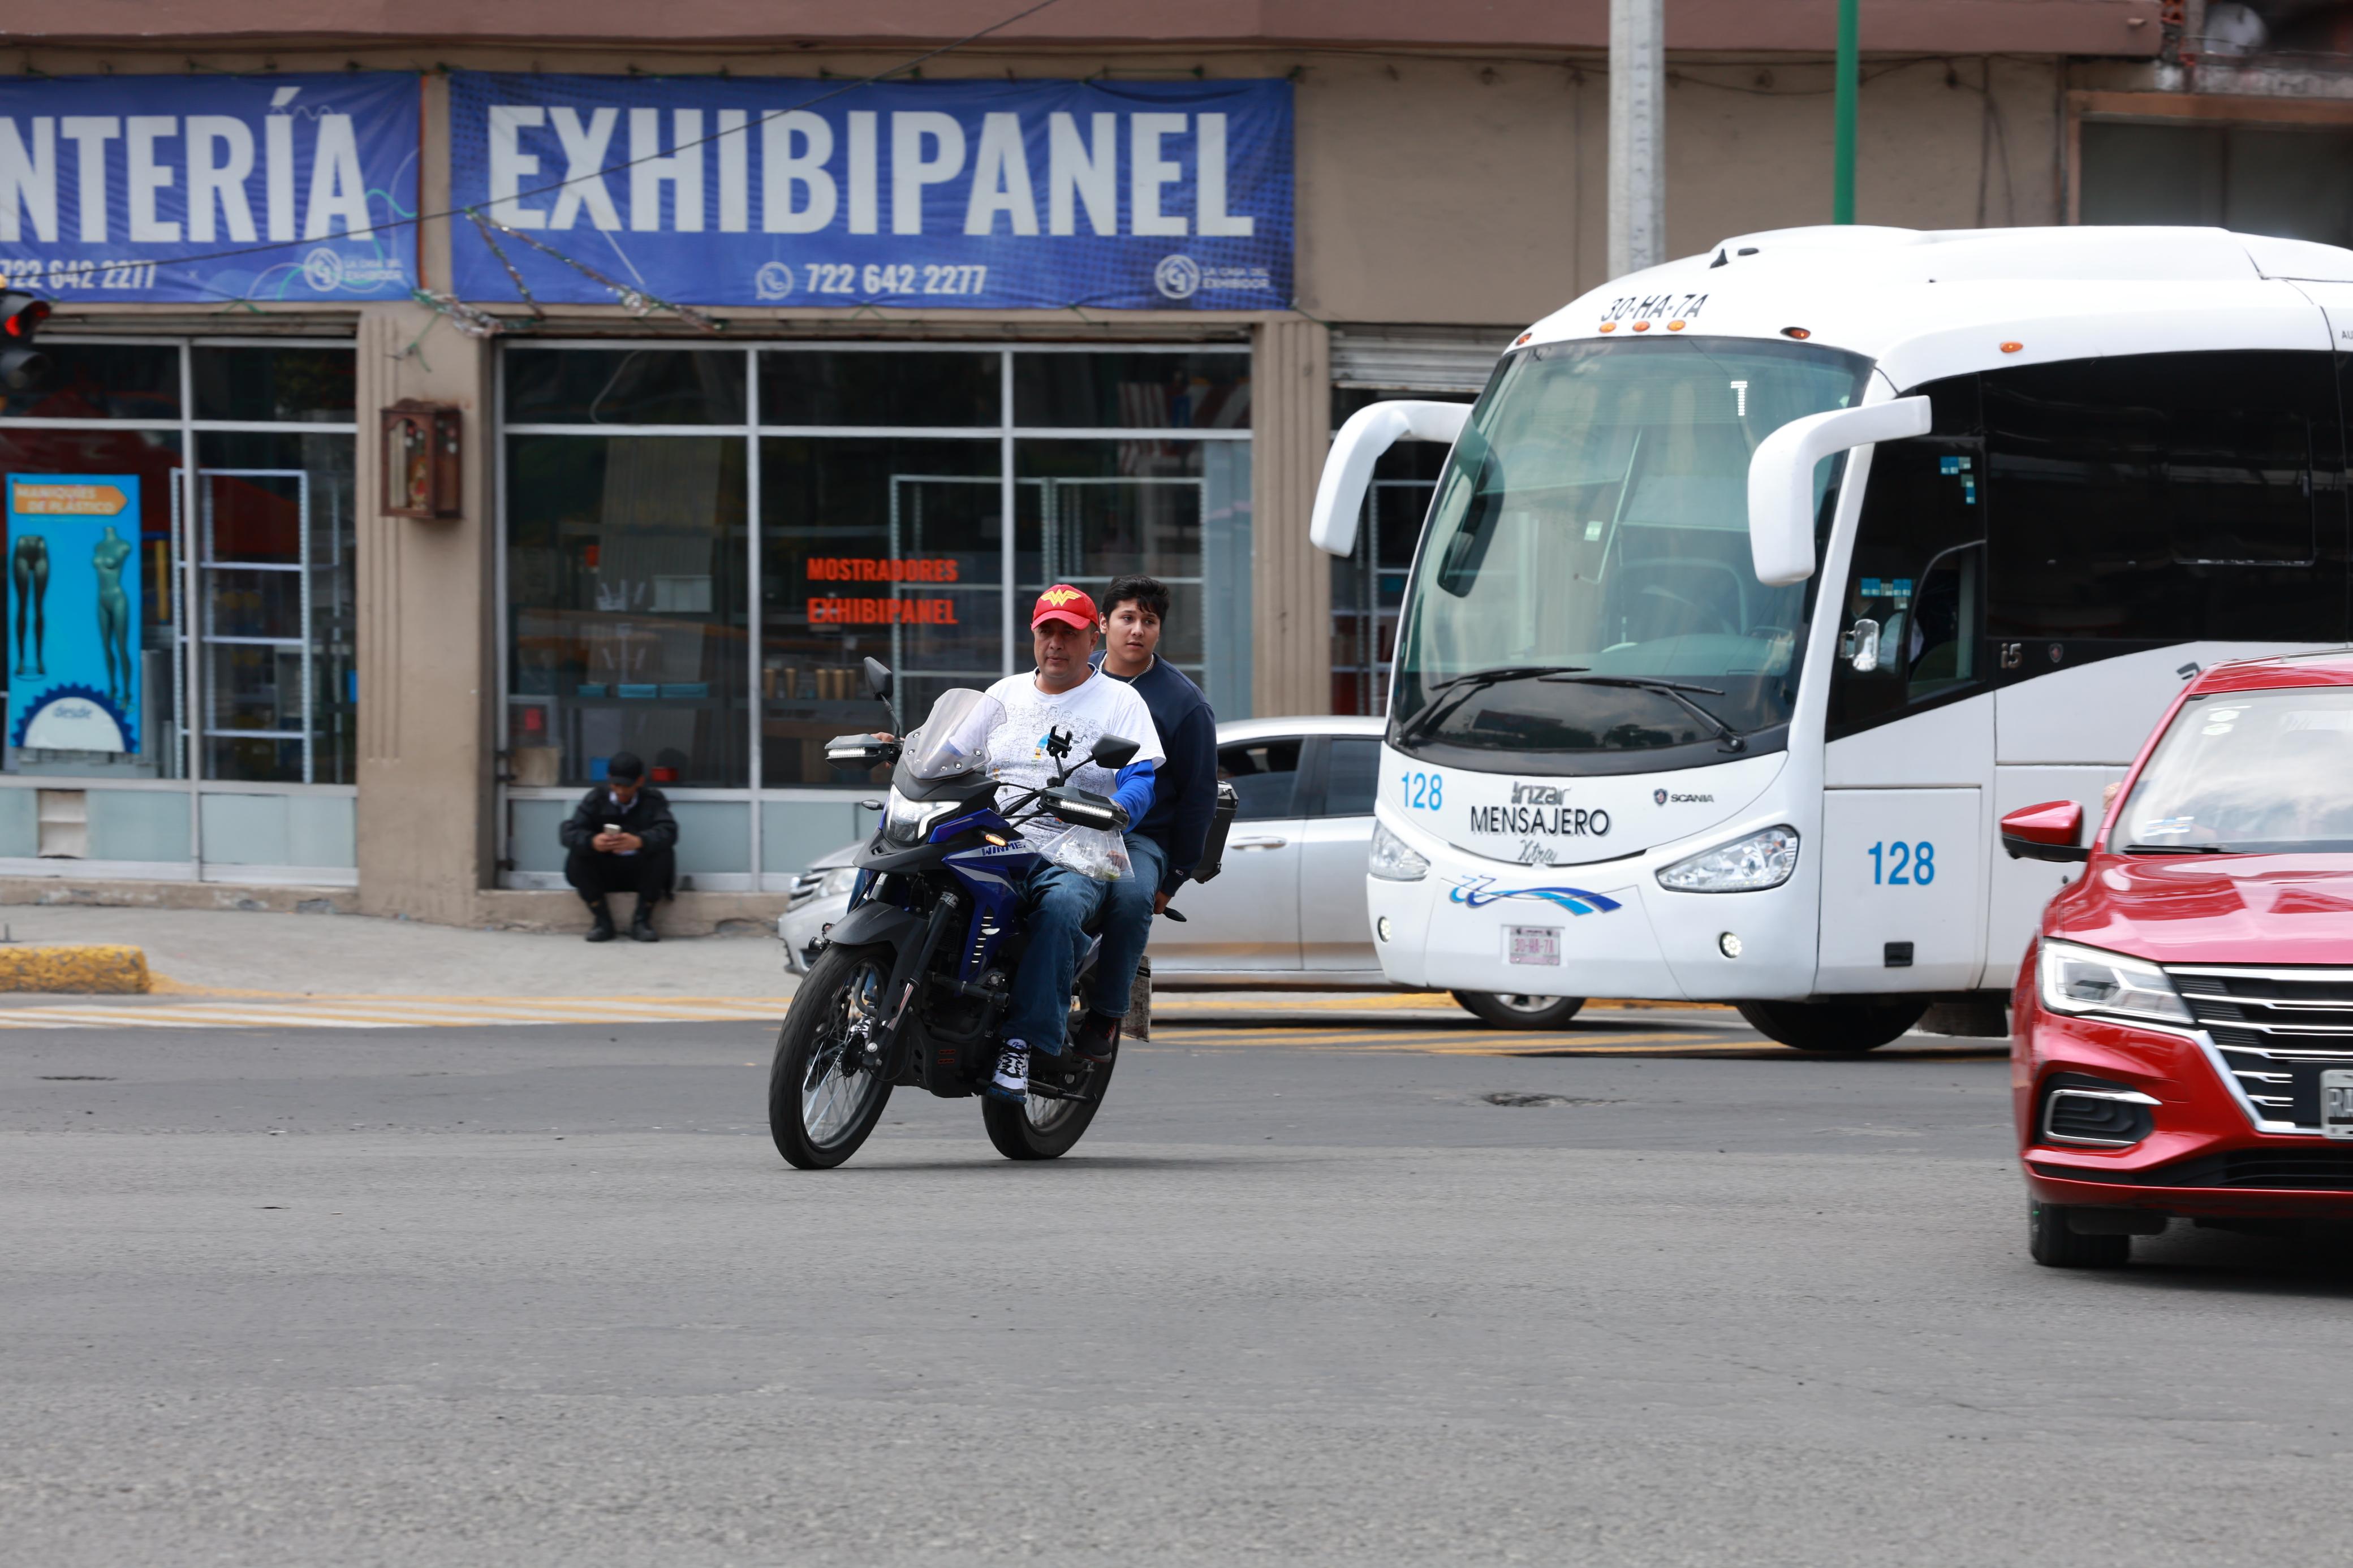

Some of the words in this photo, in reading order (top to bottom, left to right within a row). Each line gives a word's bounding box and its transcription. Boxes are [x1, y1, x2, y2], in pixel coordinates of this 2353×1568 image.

[0, 87, 374, 243] NTERÍA
[488, 105, 1254, 237] EXHIBIPANEL
[0, 259, 42, 288] 722
[48, 259, 95, 290] 642
[101, 259, 156, 289] 2277
[805, 263, 856, 293] 722
[863, 264, 916, 294] 642
[923, 264, 988, 295] 2277
[1601, 293, 1709, 322] 30-HA-7A
[807, 557, 959, 582] MOSTRADORES
[807, 597, 959, 625] EXHIBIPANEL
[2001, 642, 2023, 669] i5
[1401, 771, 1443, 811] 128
[1670, 794, 1714, 803] SCANIA
[1471, 806, 1610, 836] MENSAJERO
[1868, 840, 1935, 886] 128
